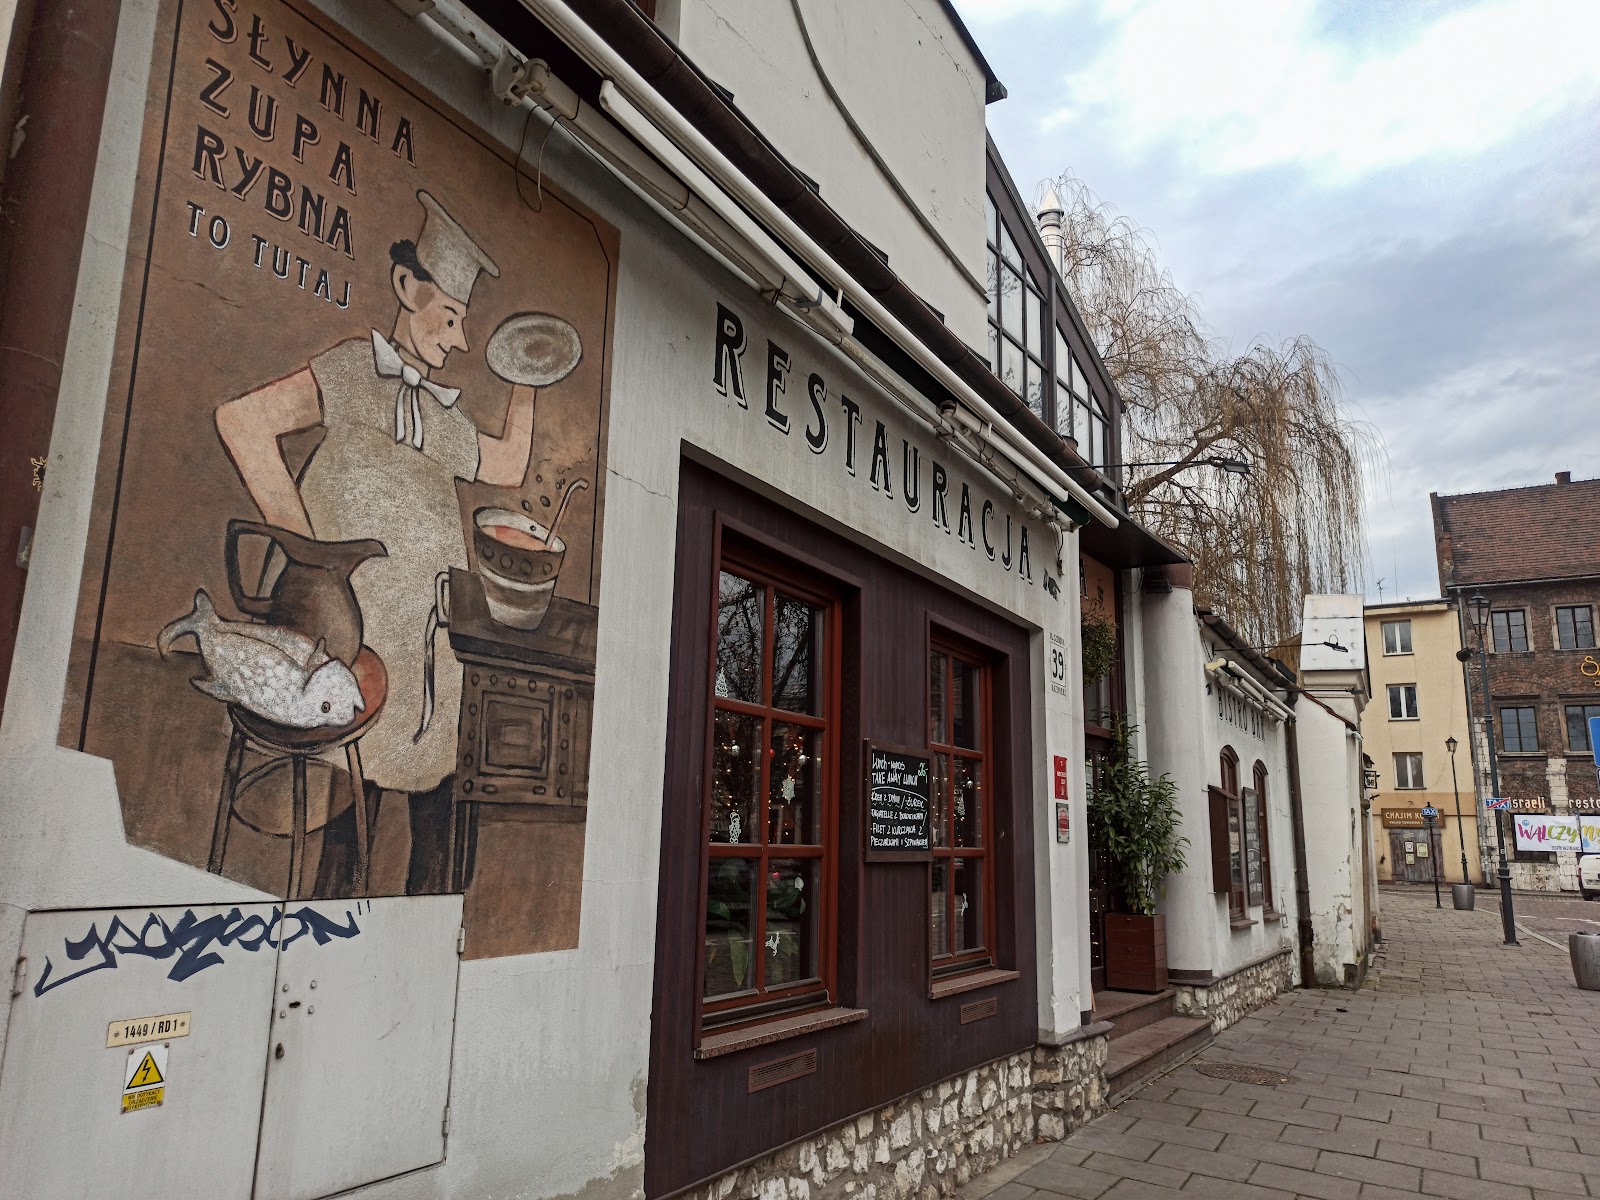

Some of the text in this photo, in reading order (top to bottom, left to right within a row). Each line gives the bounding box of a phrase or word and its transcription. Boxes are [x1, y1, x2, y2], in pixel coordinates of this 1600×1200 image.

[199, 58, 358, 196] ZUPA
[207, 0, 416, 168] SŁYNNA
[192, 125, 356, 260] RYBNA
[187, 200, 352, 310] TO TUTAJ
[712, 302, 1034, 585] RESTAURACJA
[1052, 648, 1064, 681] 39
[1385, 811, 1412, 820] CHAJIM
[124, 1023, 149, 1039] 1449
